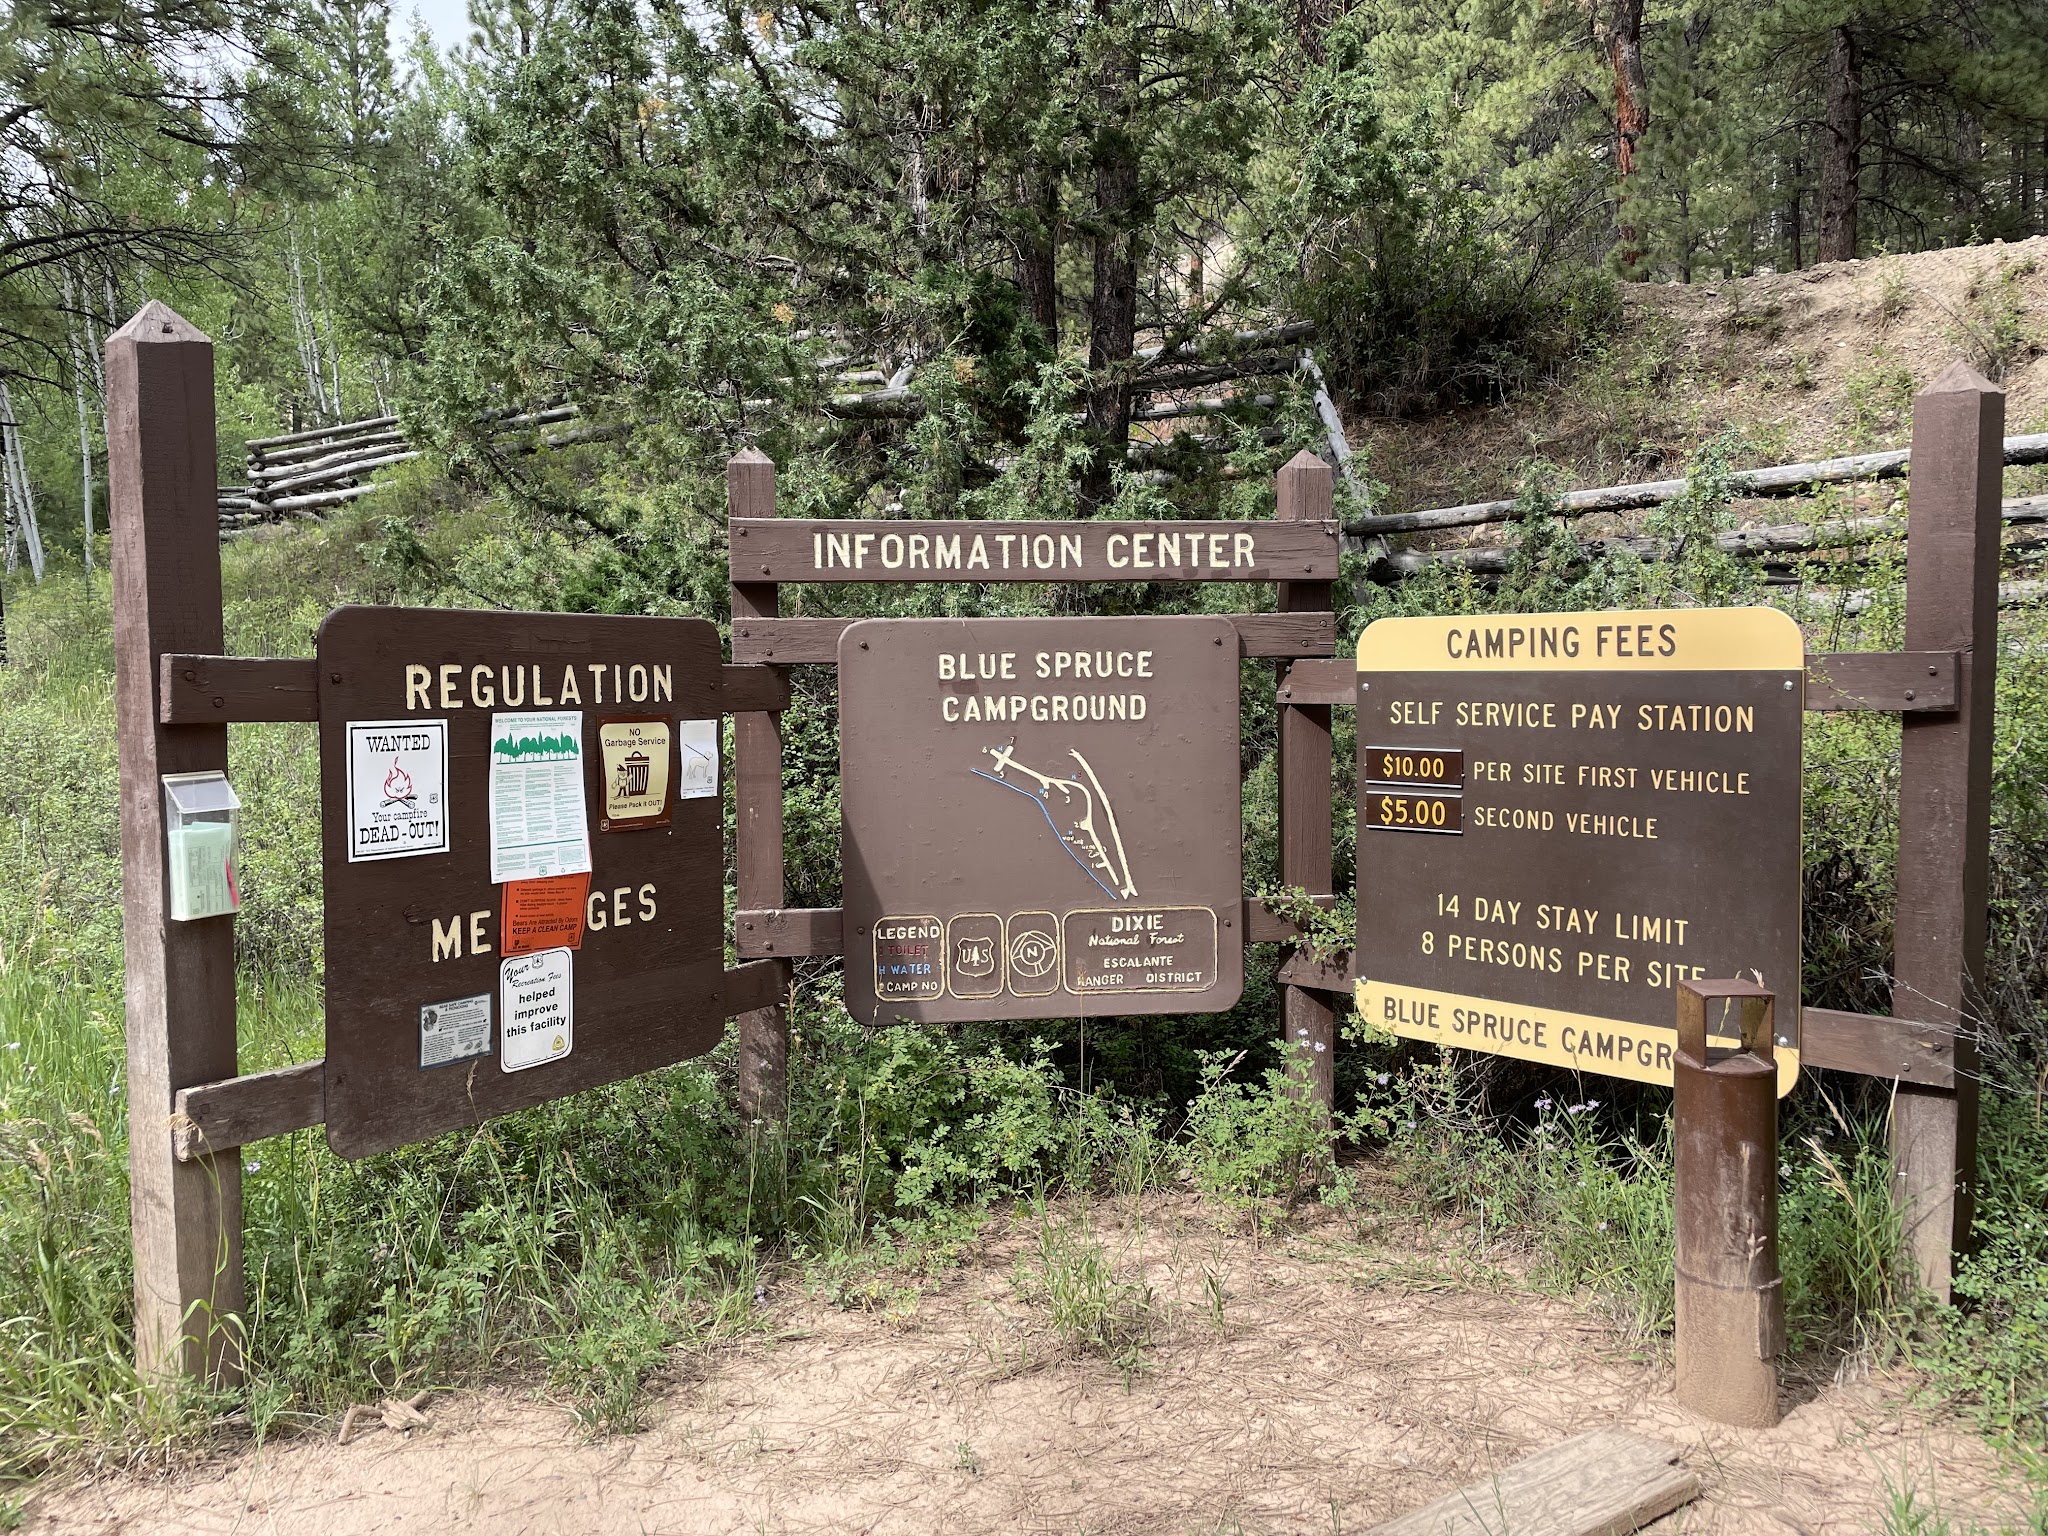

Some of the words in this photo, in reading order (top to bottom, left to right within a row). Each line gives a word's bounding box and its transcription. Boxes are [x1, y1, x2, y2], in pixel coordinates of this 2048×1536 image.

[813, 533, 1083, 569] INFORMATION
[1106, 532, 1256, 568] CENTER
[1447, 627, 1580, 659] CAMPING
[1597, 624, 1677, 657] FEES
[938, 652, 1017, 681] BLUE
[1035, 650, 1154, 679] SPRUCE
[405, 663, 673, 710] REGULATION
[942, 694, 1147, 722] CAMPGROUND
[1390, 701, 1443, 725] SELF
[1456, 702, 1556, 728] SERVICE
[1571, 704, 1622, 729] PAY
[1637, 705, 1754, 732] STATION
[629, 728, 641, 736] NO
[366, 734, 431, 753] WANTED
[604, 739, 636, 748] Garbage
[638, 737, 666, 746] Service
[1383, 754, 1444, 778] $10.00
[1474, 762, 1512, 782] PER
[1523, 764, 1566, 785] SITE
[1578, 766, 1638, 789] FIRST
[1651, 769, 1750, 795] VEHICLE
[629, 801, 641, 809] Pack
[1380, 796, 1446, 826] $5.00
[372, 812, 391, 822] Your
[393, 808, 428, 822] campfire
[1474, 807, 1554, 831] SECOND
[1566, 813, 1658, 839] VEHICLE
[432, 883, 657, 962] MEGES
[512, 919, 527, 927] Bears
[1111, 915, 1164, 932] DIXIE
[1437, 893, 1459, 917] 14
[1475, 897, 1521, 925] DAY
[1536, 904, 1599, 935] STAY
[1615, 913, 1689, 946] LIMIT
[512, 927, 531, 935] KEEP
[537, 925, 558, 933] CLEAN
[877, 926, 940, 940] LEGEND
[1088, 934, 1139, 947] National
[1149, 932, 1184, 945] Forest
[888, 944, 928, 956] TOILET
[1027, 946, 1038, 958] N
[1421, 931, 1434, 955] 8
[1449, 935, 1563, 973] PERSONS
[1578, 952, 1630, 982] PER
[890, 963, 931, 975] WATER
[1103, 956, 1173, 968] ESCALANTE
[504, 964, 530, 983] Your
[512, 976, 546, 989] Recreation
[548, 972, 562, 983] Fees
[1077, 974, 1124, 987] RANGER
[1146, 972, 1202, 983] DISTRICT
[519, 987, 556, 1004] helped
[886, 981, 918, 992] CAMP
[921, 981, 938, 991] NO
[514, 1003, 559, 1021] improve
[506, 1025, 527, 1038] this
[530, 1016, 567, 1032] facility
[1383, 996, 1440, 1029] BLUE
[1452, 1008, 1547, 1048] SPRUCE
[1561, 1026, 1672, 1071] CAMPGR
